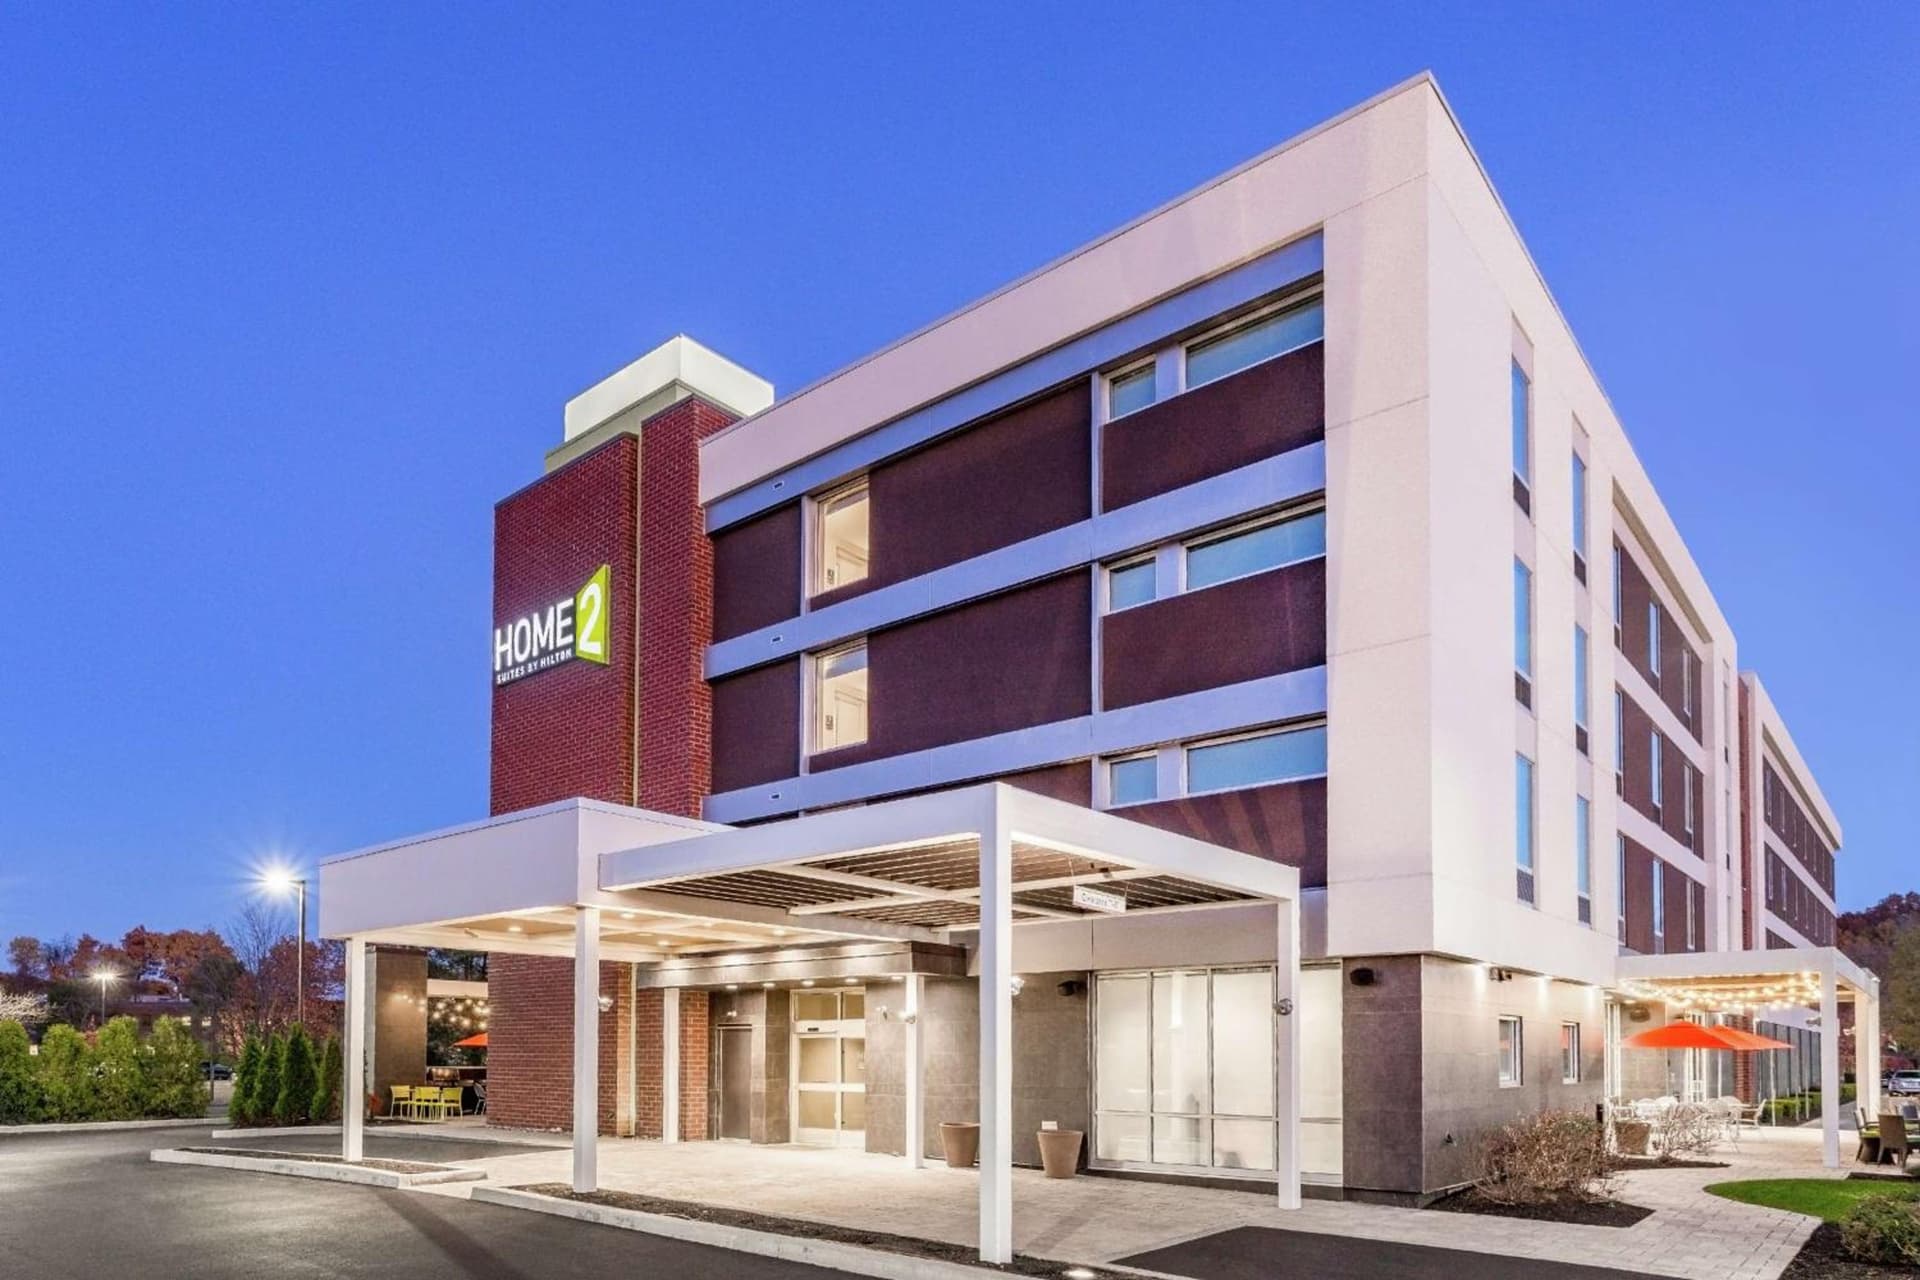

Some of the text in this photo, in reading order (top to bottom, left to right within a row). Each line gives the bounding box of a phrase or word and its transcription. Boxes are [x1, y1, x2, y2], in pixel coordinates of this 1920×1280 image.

[494, 582, 602, 671] HOME 2
[496, 648, 572, 685] SUITES BY HILTON
